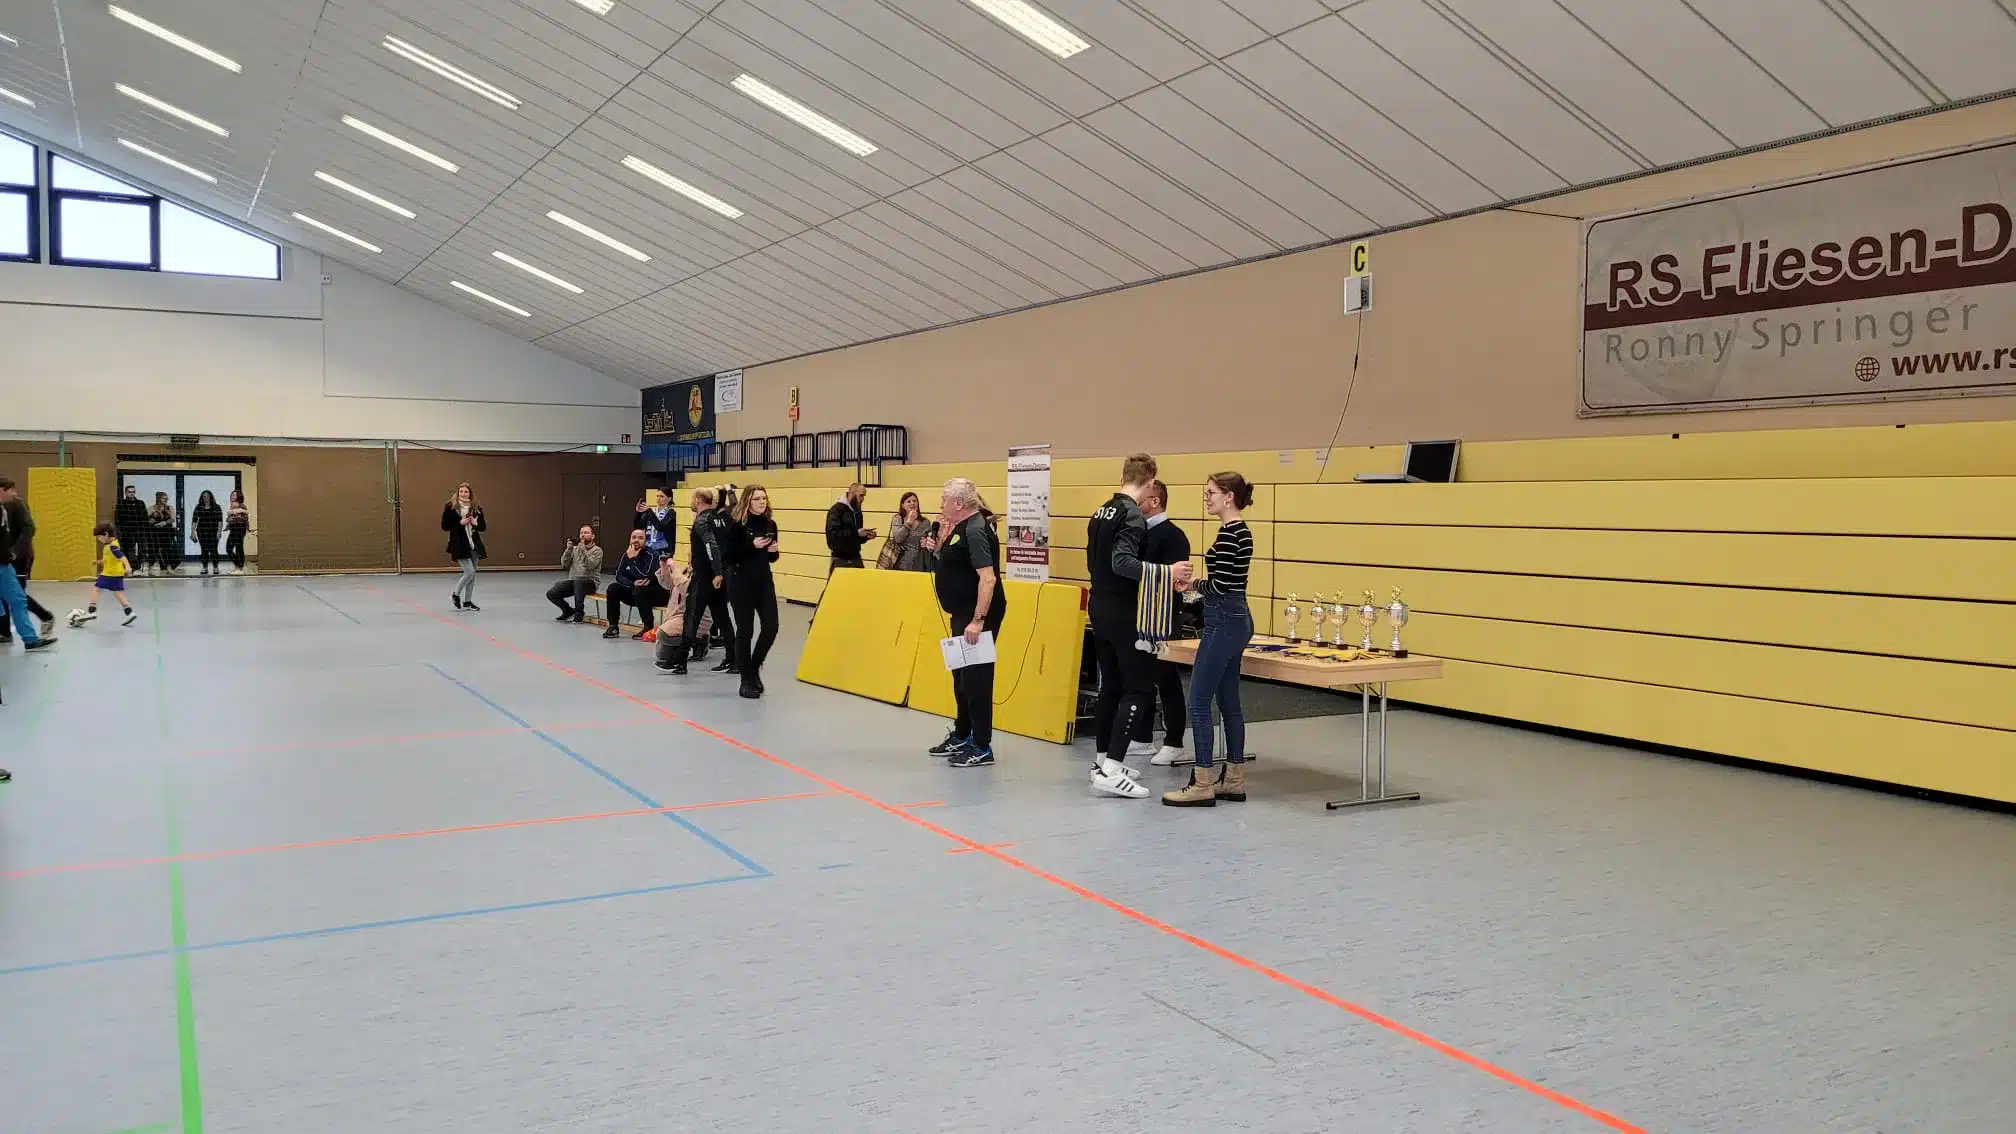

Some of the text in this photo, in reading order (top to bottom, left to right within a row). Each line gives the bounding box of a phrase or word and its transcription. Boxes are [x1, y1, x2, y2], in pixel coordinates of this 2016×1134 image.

[1354, 245, 1365, 272] C
[1607, 202, 2014, 310] RS Fliesen-D
[1605, 302, 1979, 365] Ronny Springer
